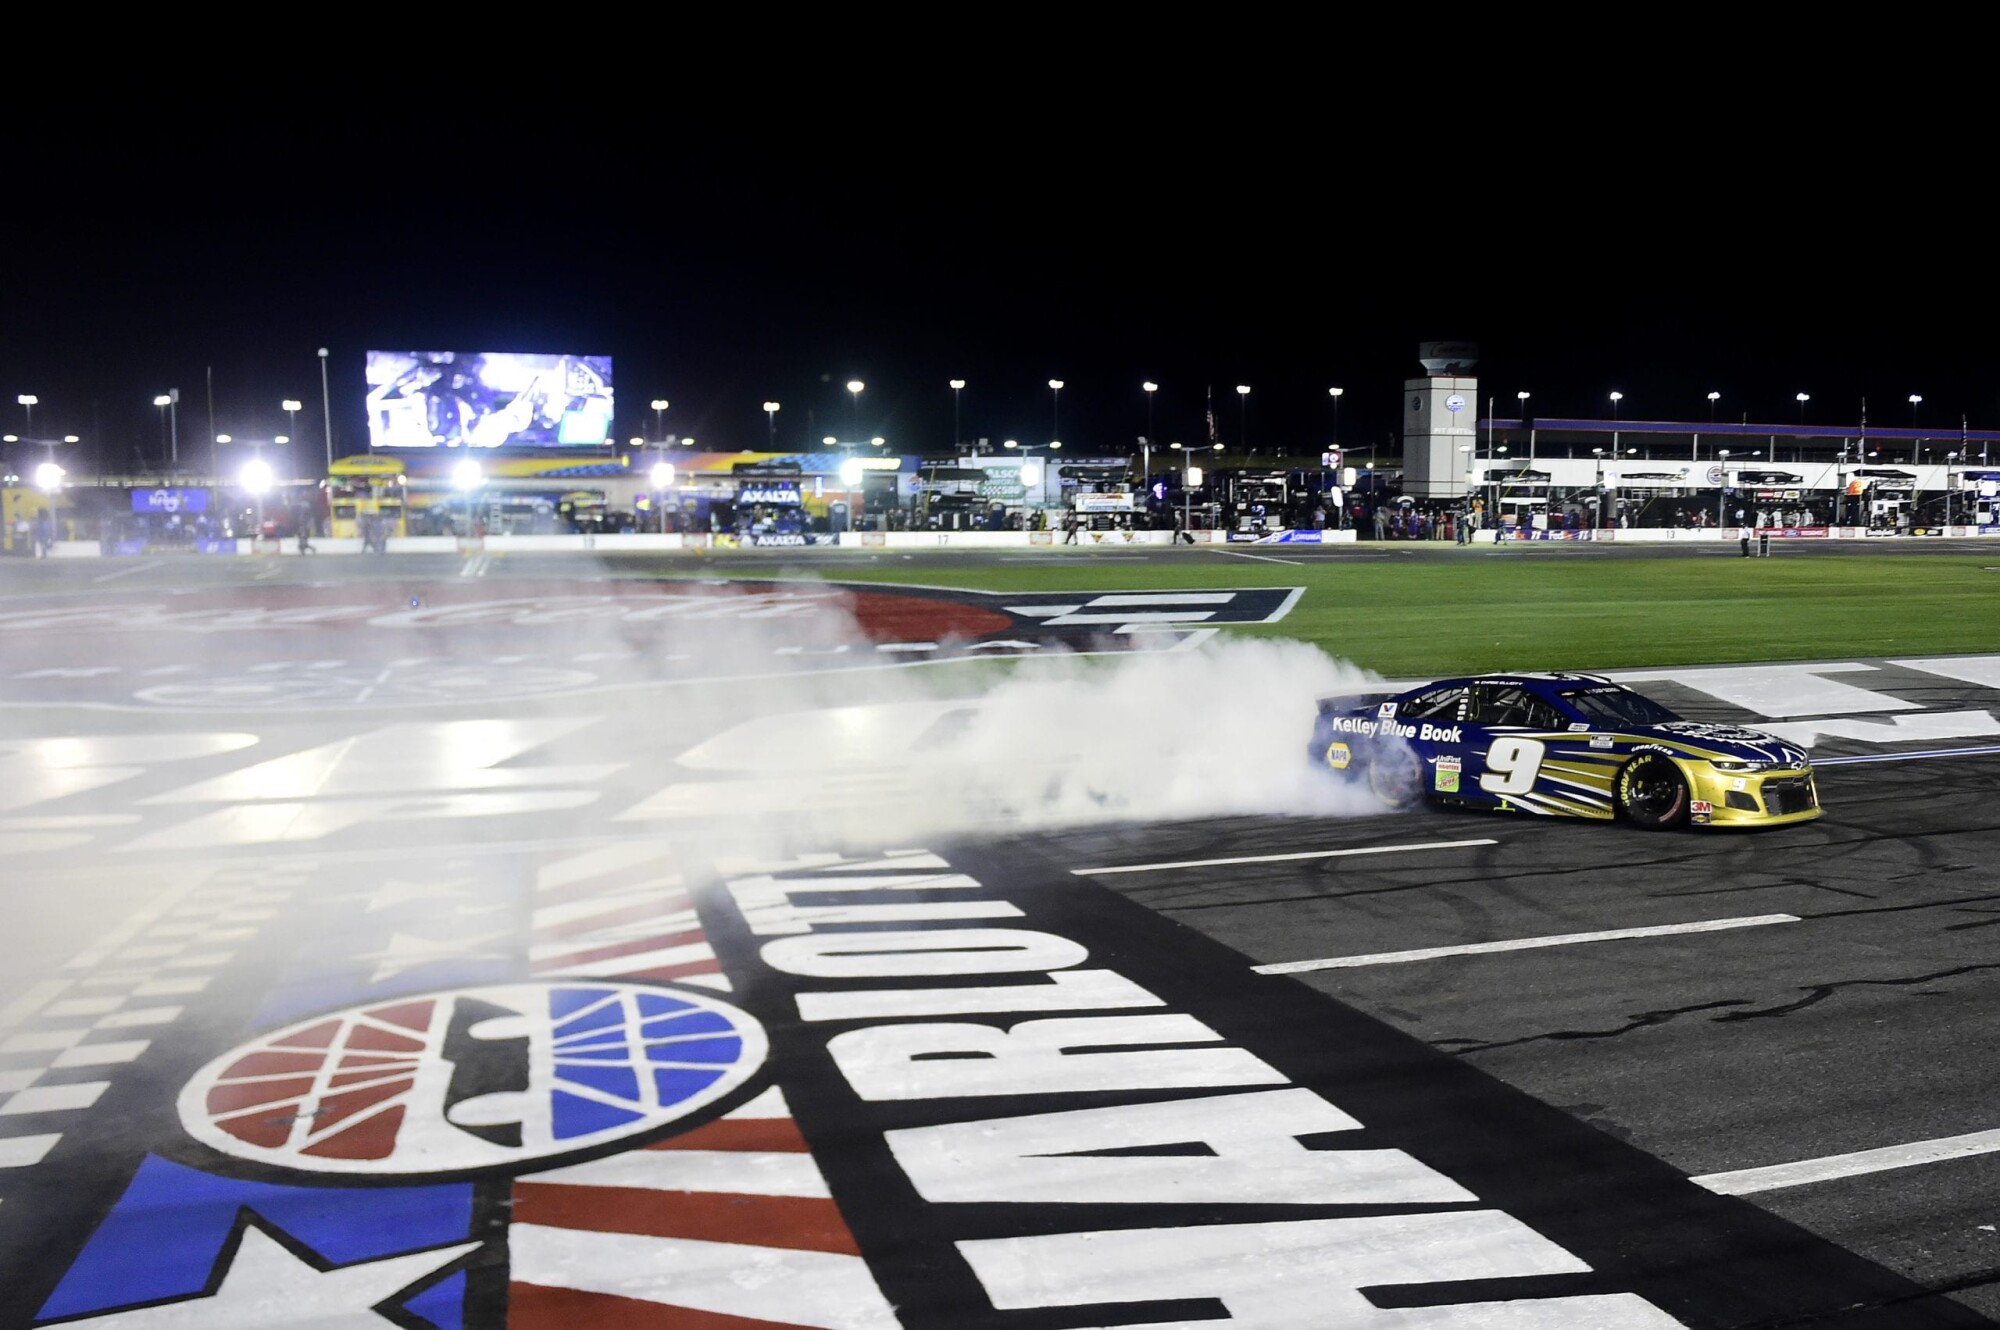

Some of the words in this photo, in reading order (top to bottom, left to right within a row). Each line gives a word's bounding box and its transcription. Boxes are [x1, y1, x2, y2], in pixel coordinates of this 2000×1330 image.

[741, 490, 800, 502] AXALTA
[757, 534, 805, 546] AXALTA
[938, 534, 949, 545] 17
[1666, 530, 1675, 539] 13
[1333, 716, 1378, 738] Kelley
[1380, 719, 1417, 738] Blue
[1419, 723, 1463, 743] Book
[1631, 743, 1674, 755] GOODYEAR
[1331, 749, 1347, 762] NAPA
[1436, 754, 1461, 763] UniFirst
[1480, 737, 1545, 795] 9
[1732, 778, 1746, 791] 9
[1692, 801, 1711, 812] 3M
